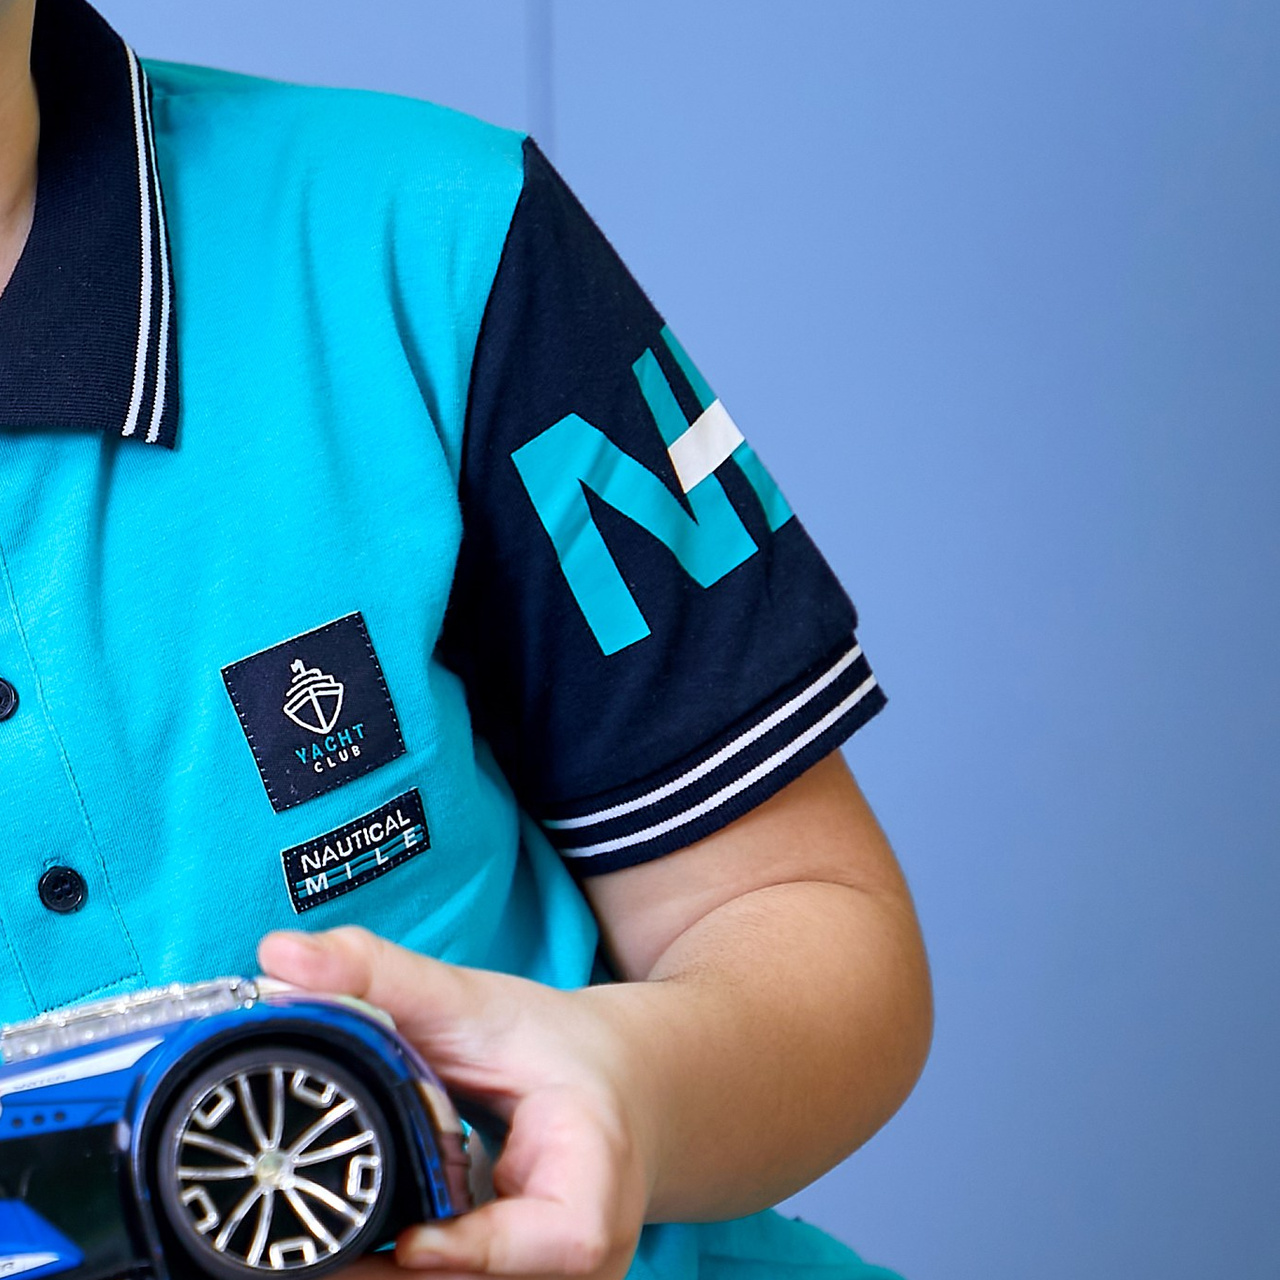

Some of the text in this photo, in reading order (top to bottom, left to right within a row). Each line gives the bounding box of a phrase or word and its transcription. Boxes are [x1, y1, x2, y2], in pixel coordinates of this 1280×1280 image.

[295, 723, 365, 764] YACHT
[313, 744, 362, 773] CLUB
[300, 808, 411, 873] NAUTICAL
[305, 830, 419, 896] MILE
